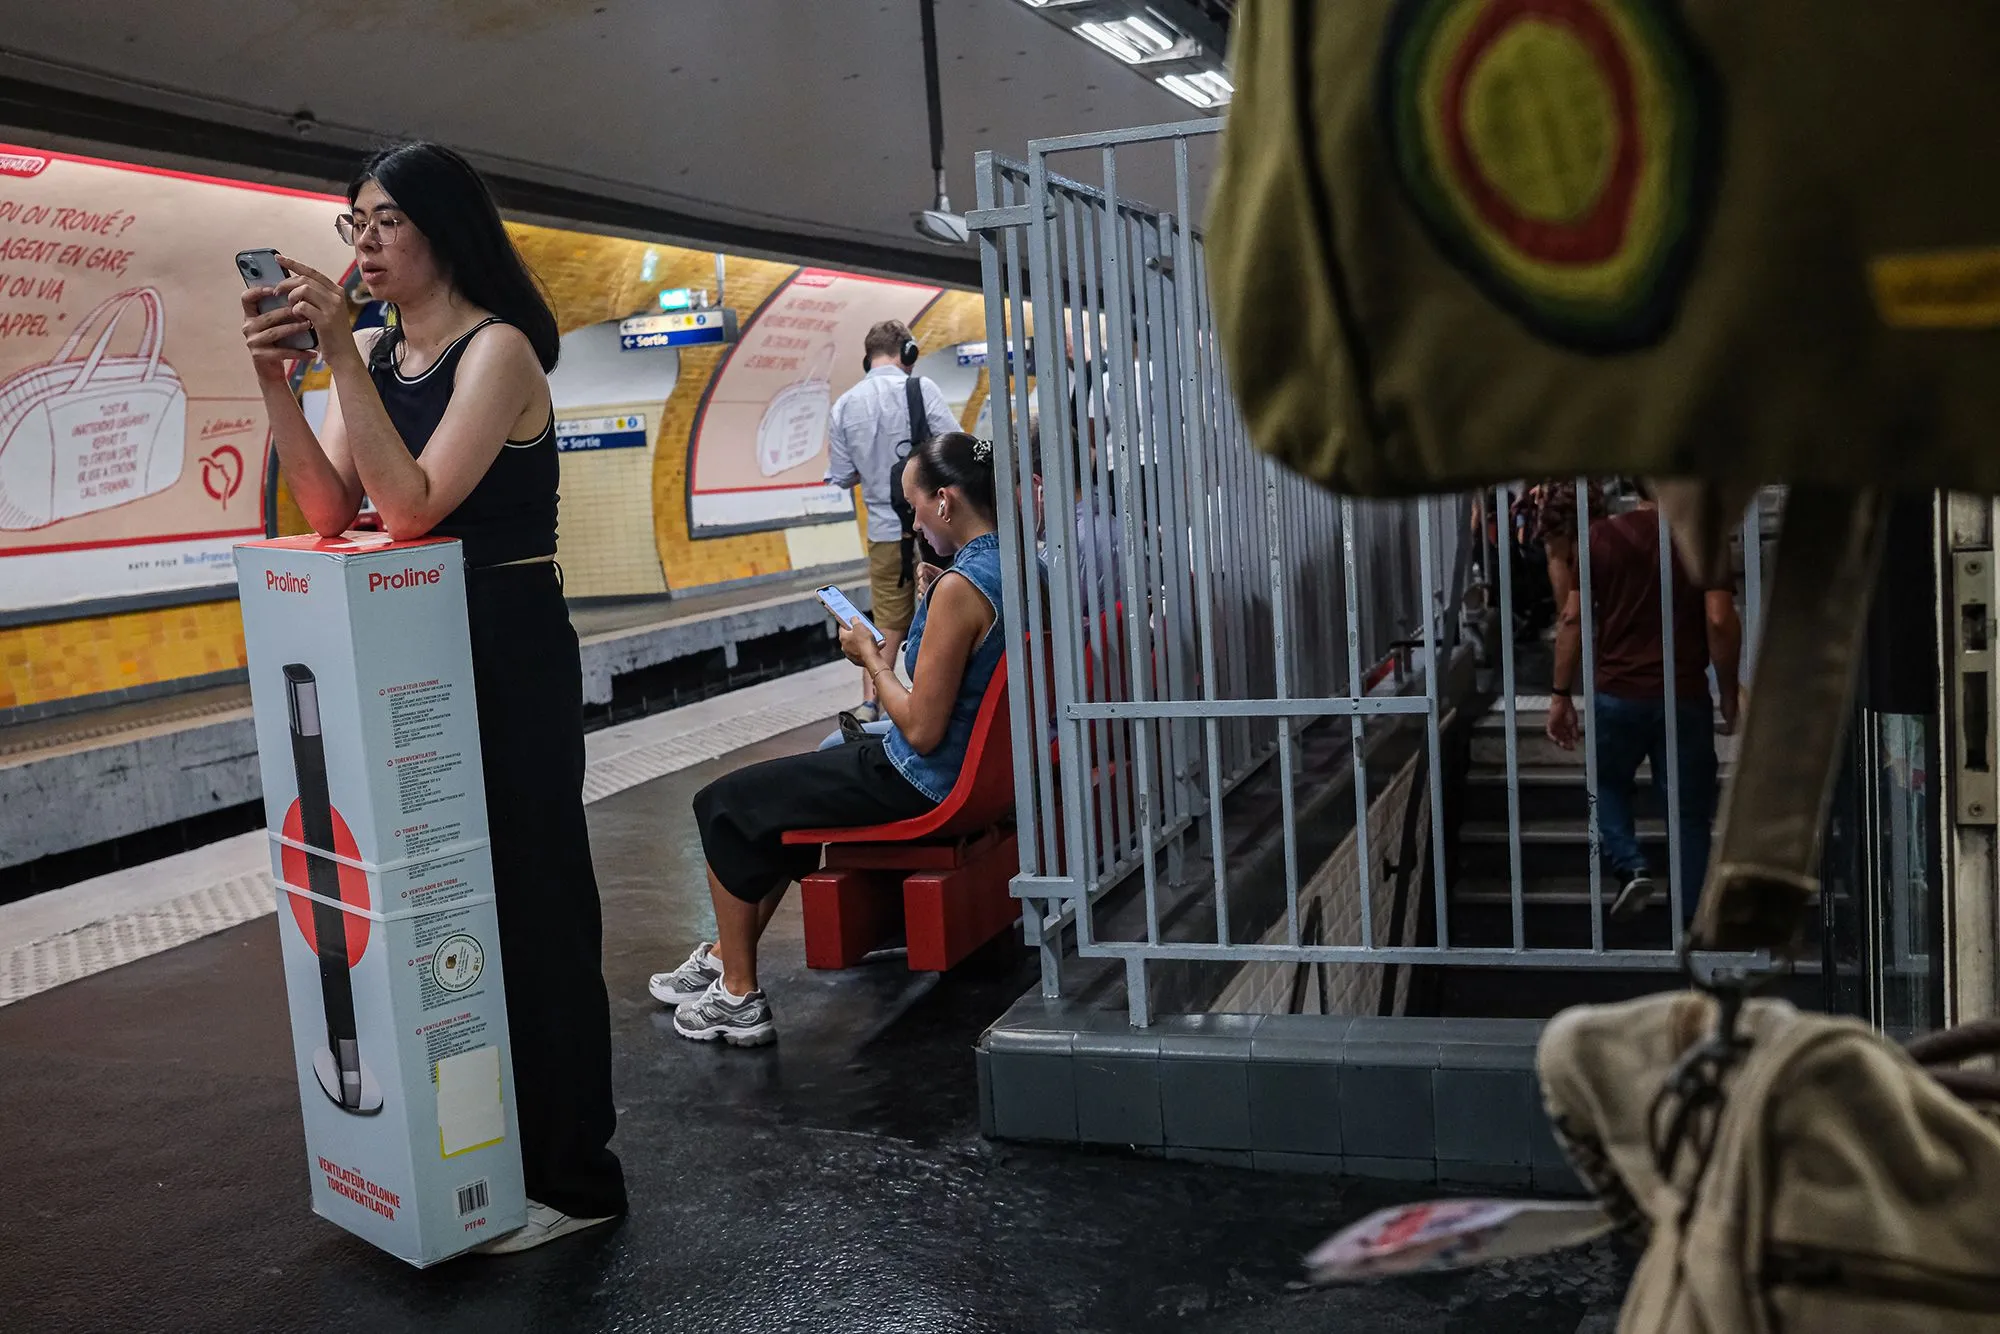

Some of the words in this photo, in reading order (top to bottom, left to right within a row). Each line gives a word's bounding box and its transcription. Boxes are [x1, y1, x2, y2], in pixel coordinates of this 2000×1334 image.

[21, 204, 51, 225] OU
[50, 207, 124, 235] TROUVÉ
[57, 245, 90, 267] EN
[85, 247, 135, 279] GARE,
[9, 276, 36, 298] OU
[36, 278, 65, 303] VIA
[636, 334, 669, 347] Sortie
[570, 436, 601, 449] Sortie
[387, 682, 418, 694] VENTILATEUR
[395, 751, 437, 764] TORENVENTILATOR
[419, 823, 429, 831] FAN
[318, 1155, 365, 1191] VENTILATEUR
[366, 1181, 401, 1209] COLONNE
[326, 1175, 395, 1221] TORENVENTILATOR
[464, 1217, 486, 1232] PTF40
